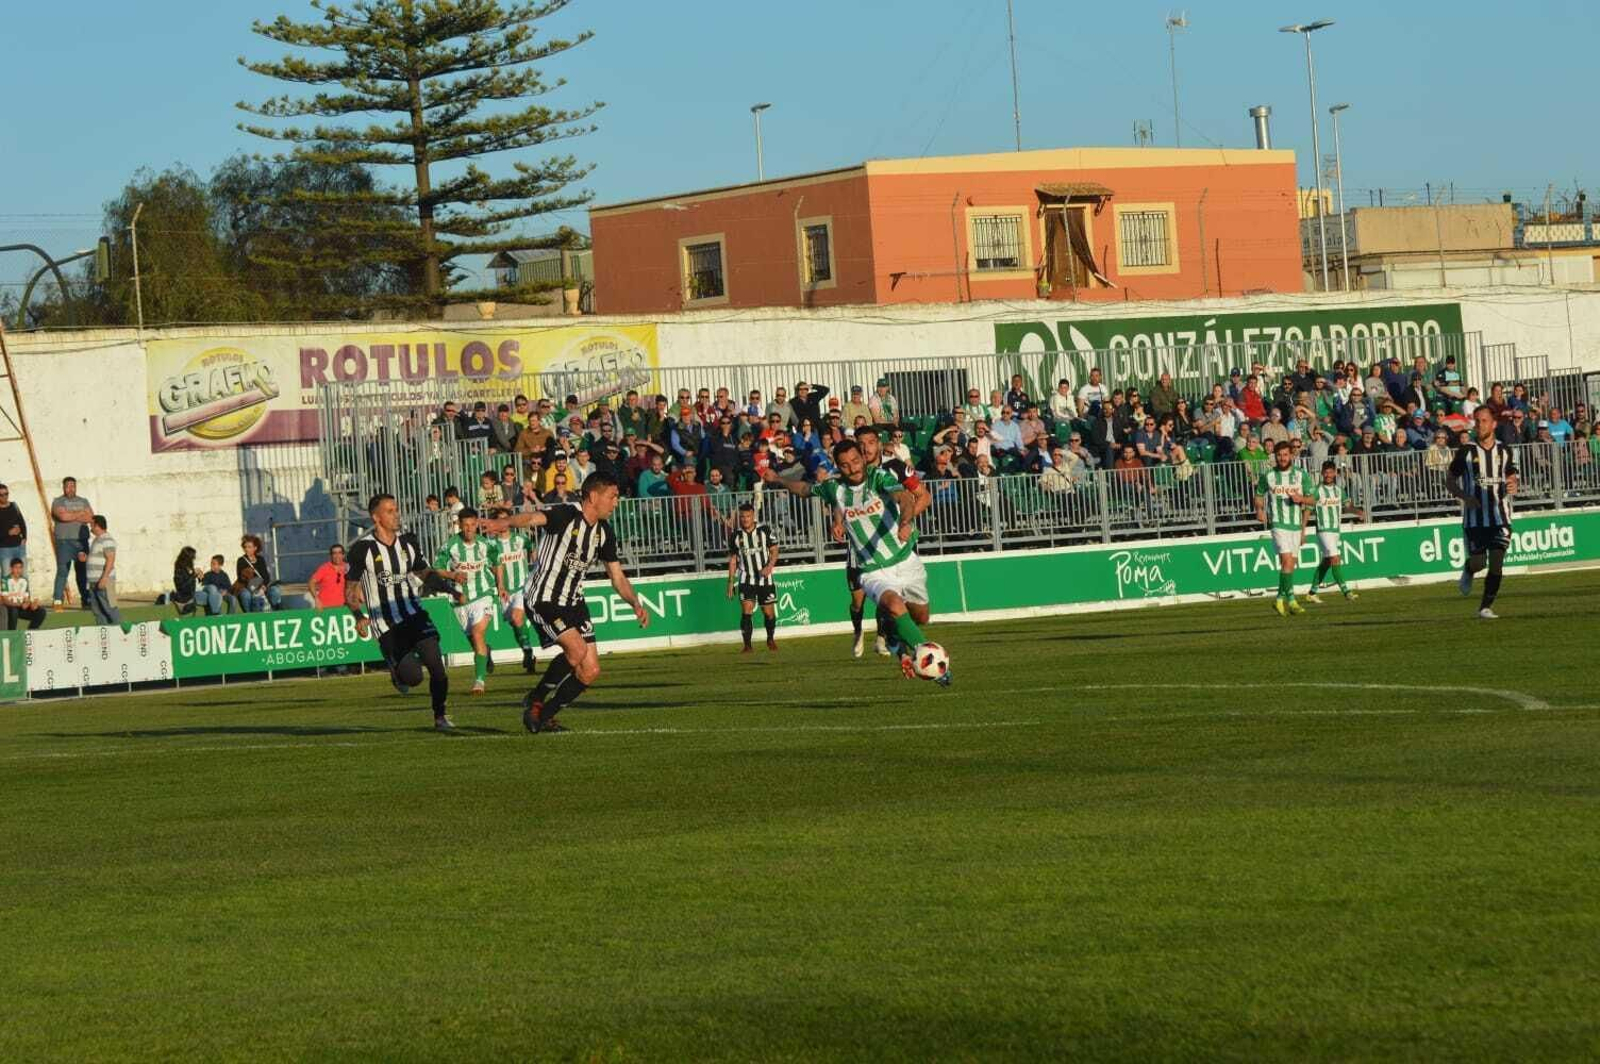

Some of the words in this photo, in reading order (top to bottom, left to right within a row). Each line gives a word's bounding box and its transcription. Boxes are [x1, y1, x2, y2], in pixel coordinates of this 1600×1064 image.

[300, 340, 523, 389] ROTULOS
[1419, 528, 1442, 563] el
[180, 619, 303, 657] GONZALEZ
